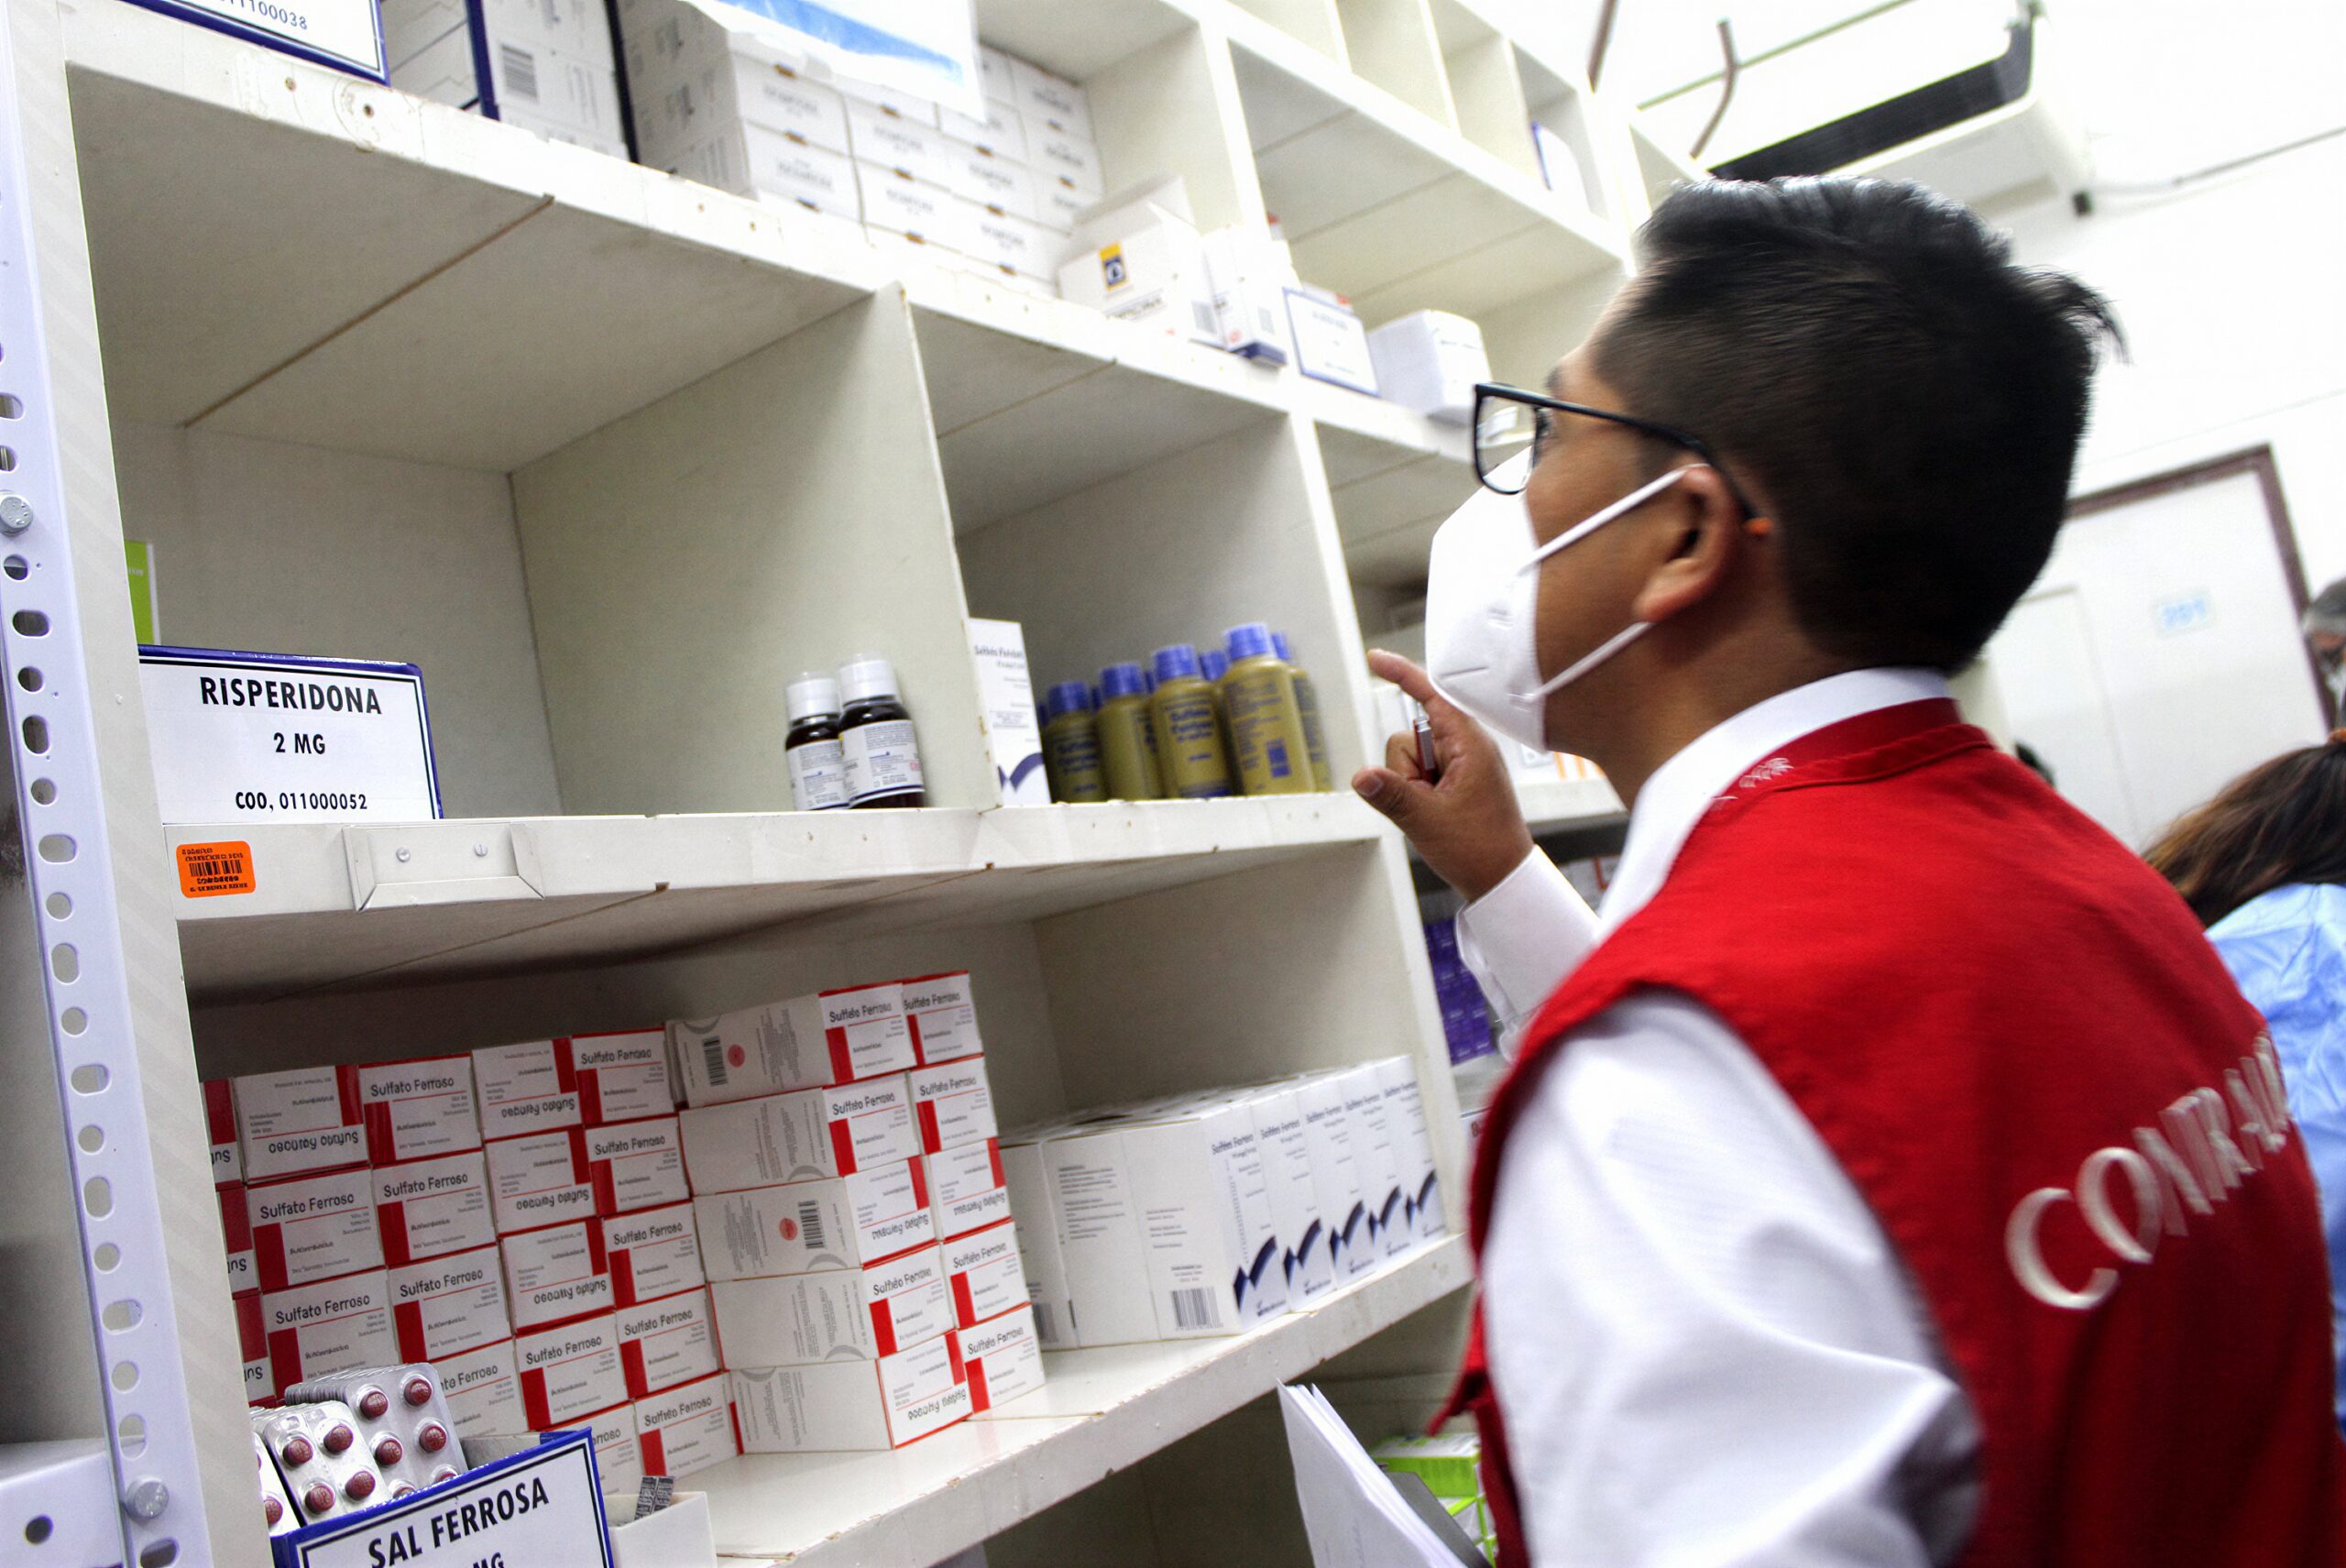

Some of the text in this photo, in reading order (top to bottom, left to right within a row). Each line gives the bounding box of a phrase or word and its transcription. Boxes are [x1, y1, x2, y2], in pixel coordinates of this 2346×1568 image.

[200, 676, 382, 715] RISPERIDONA
[273, 732, 326, 754] 2 MG
[280, 793, 367, 810] 011000052
[581, 1050, 616, 1065] Sulfato
[370, 1078, 455, 1097] Sulfato Ferroso
[594, 1141, 629, 1156] Sulfato
[383, 1171, 469, 1199] Sulfato Ferroso
[260, 1192, 356, 1220] Sulfato Ferroso
[614, 1222, 684, 1246] Sulfato Ferroso
[400, 1268, 484, 1298] Sulfato Ferroso
[275, 1294, 370, 1325] Sulfato Ferroso
[624, 1309, 693, 1338] Sulfato Ferroso
[526, 1335, 603, 1365] Sulfato Ferroso
[458, 1364, 499, 1386] Ferroso
[643, 1397, 713, 1428] Sulfato Ferroso
[368, 1476, 550, 1568] SAL FERROSA
